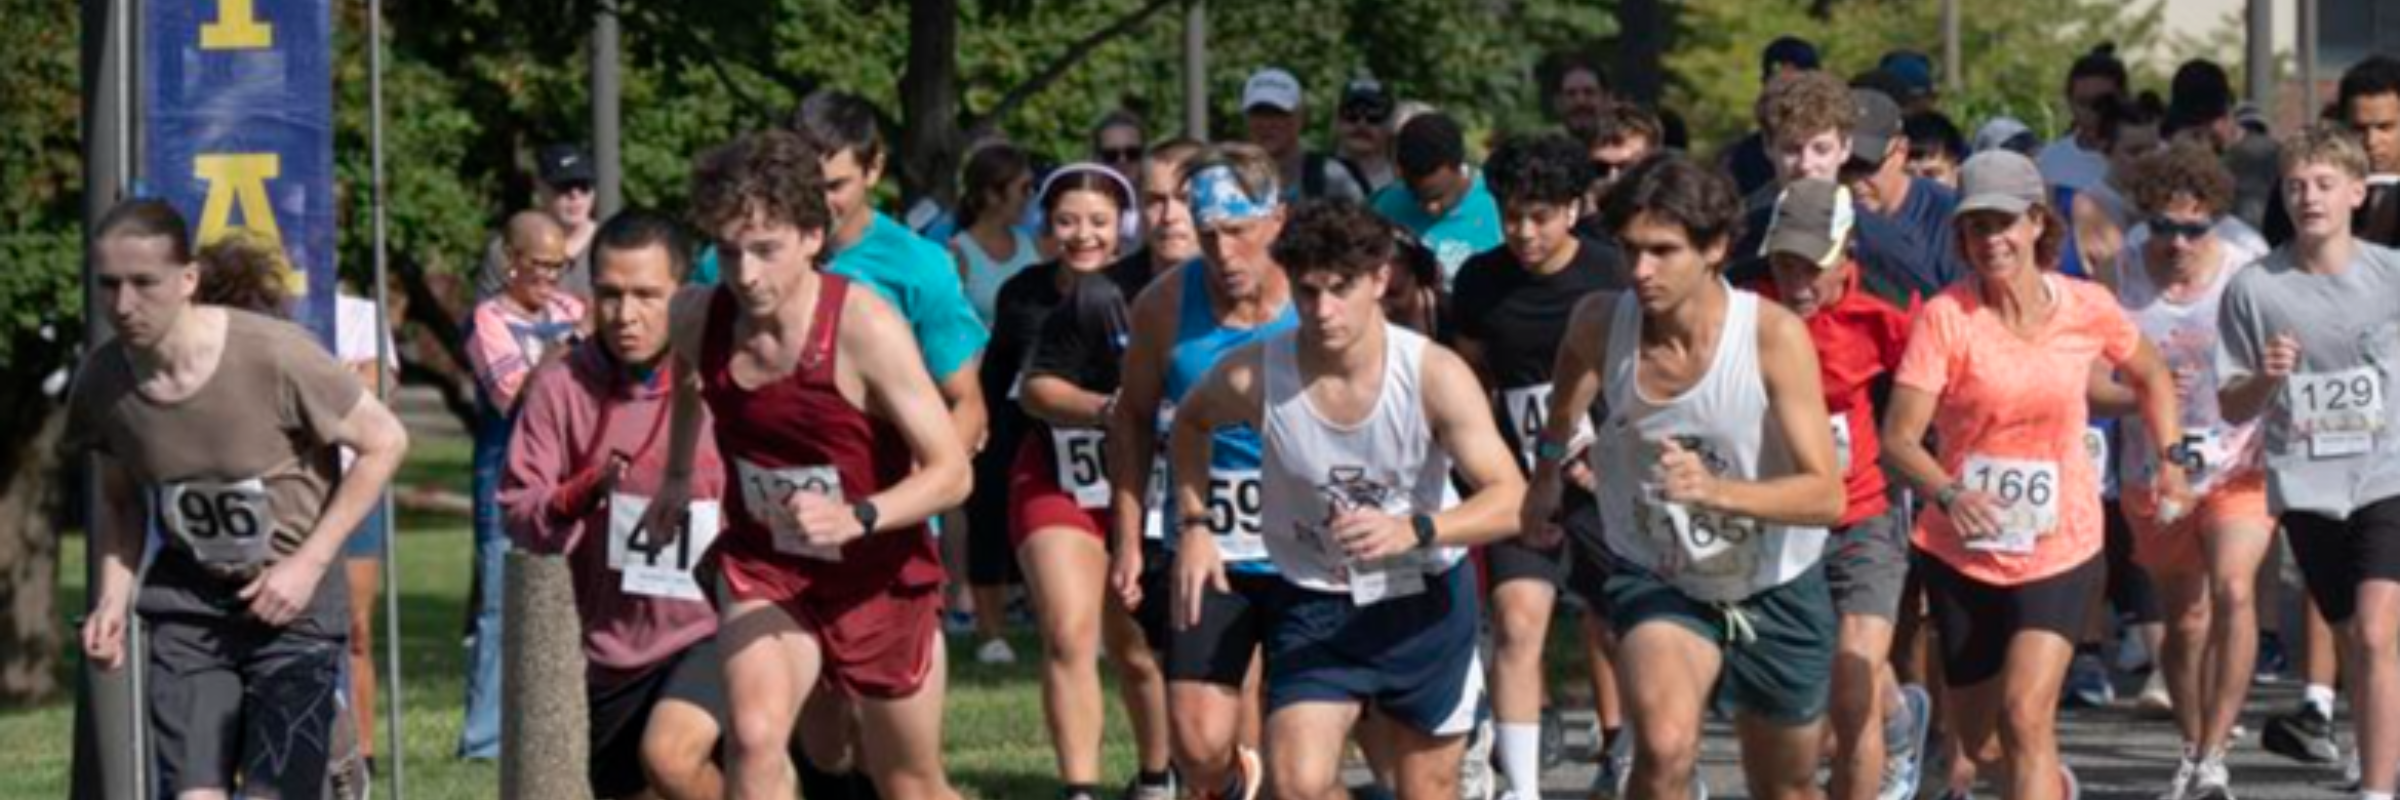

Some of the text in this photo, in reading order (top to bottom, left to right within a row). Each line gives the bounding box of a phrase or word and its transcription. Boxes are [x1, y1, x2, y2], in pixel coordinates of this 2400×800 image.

[2302, 375, 2373, 411] 129
[1067, 437, 1106, 487] 5
[1976, 466, 2053, 508] 166
[178, 489, 257, 539] 96
[1207, 480, 1262, 535] 59
[1663, 511, 1748, 548] 165
[626, 508, 692, 571] 41
